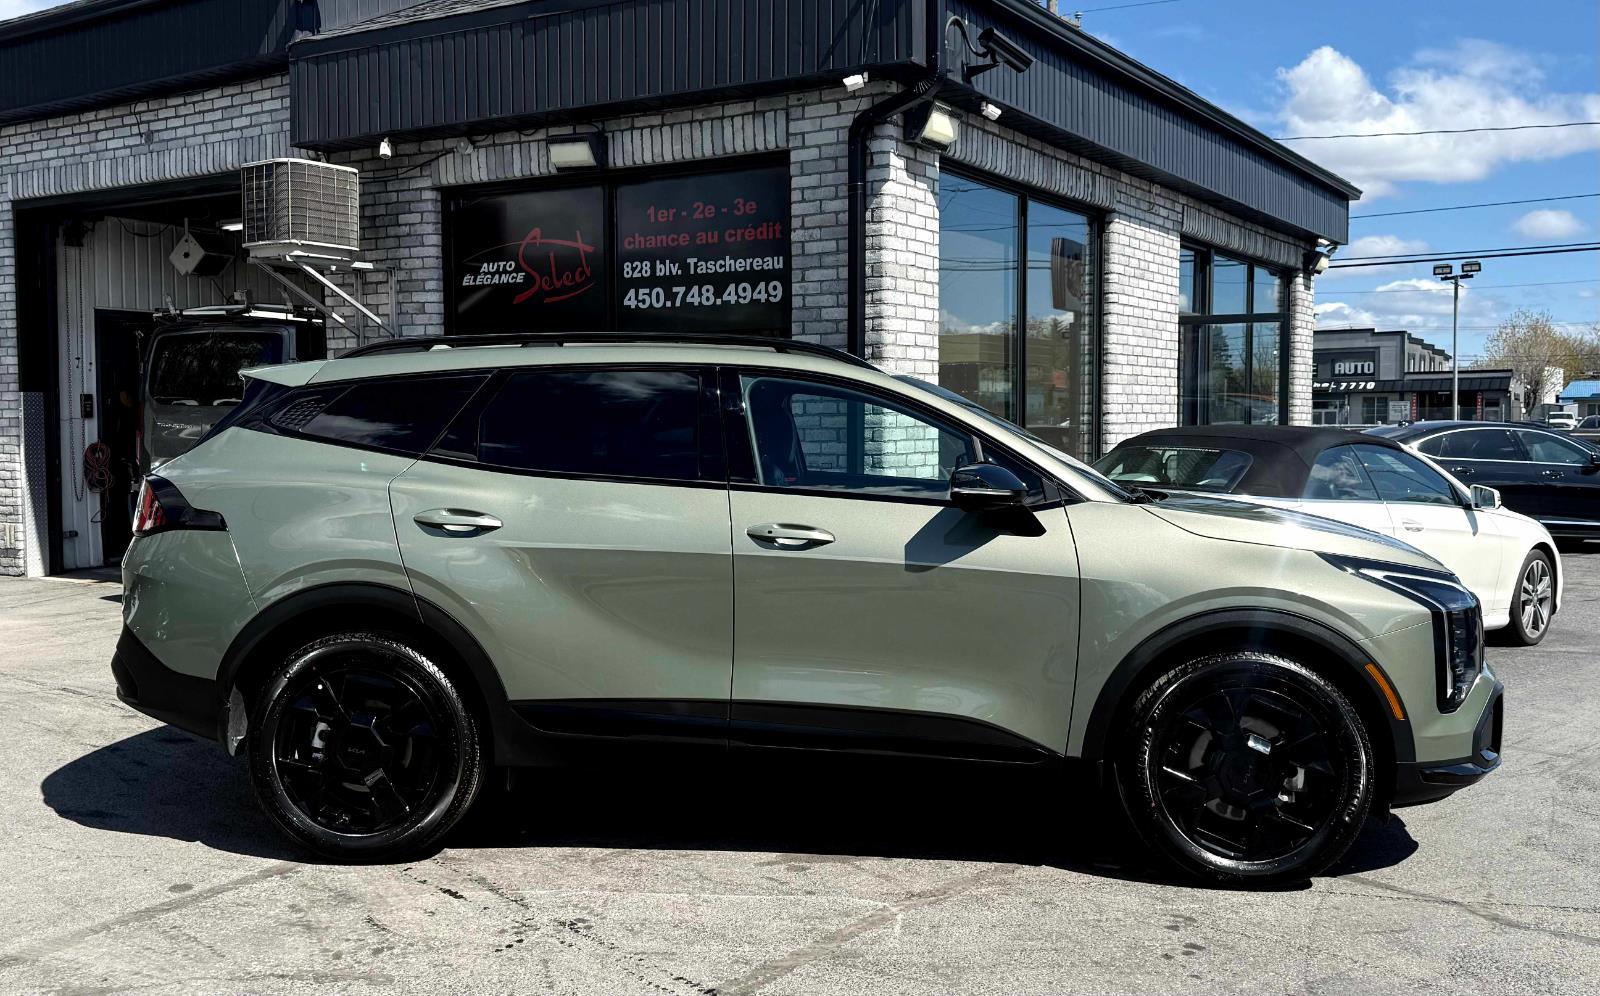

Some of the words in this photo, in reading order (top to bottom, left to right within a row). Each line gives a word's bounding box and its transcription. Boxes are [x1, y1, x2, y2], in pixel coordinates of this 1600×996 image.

[647, 206, 676, 224] 1er
[693, 202, 716, 219] 2e
[733, 198, 757, 214] 3e
[623, 233, 690, 249] chance
[695, 230, 719, 244] au
[724, 223, 782, 242] crédit
[480, 261, 516, 273] AUTO
[513, 227, 593, 304] Select
[623, 260, 650, 278] 828
[655, 259, 682, 277] blv.
[687, 256, 784, 275] Taschereau
[462, 273, 526, 286] ÉLÉGANCE
[623, 281, 783, 309] 450.748.4949
[1334, 361, 1374, 374] AUTO
